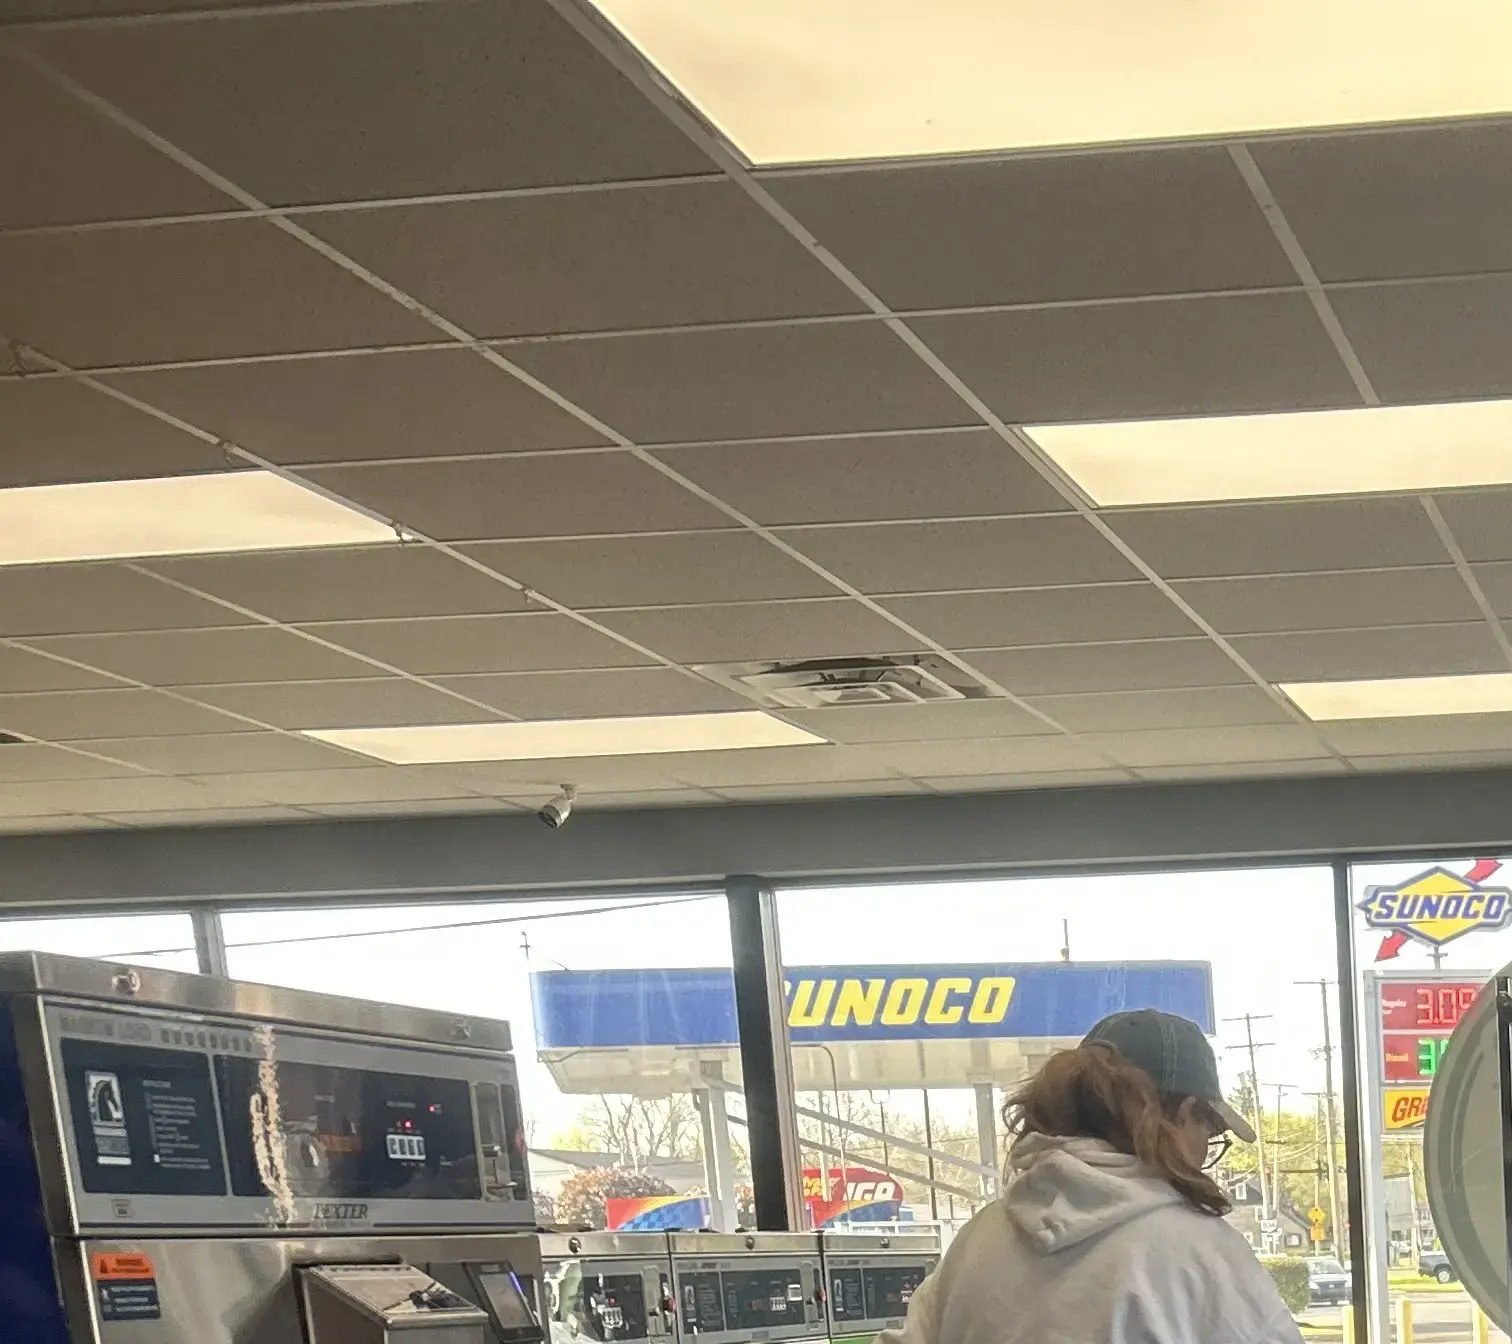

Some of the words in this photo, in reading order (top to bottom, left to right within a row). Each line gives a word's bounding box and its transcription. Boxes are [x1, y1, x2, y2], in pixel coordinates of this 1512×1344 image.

[1374, 894, 1507, 920] SUNOCO
[783, 977, 1016, 1027] UNOCO
[314, 1203, 368, 1220] DEXTER
